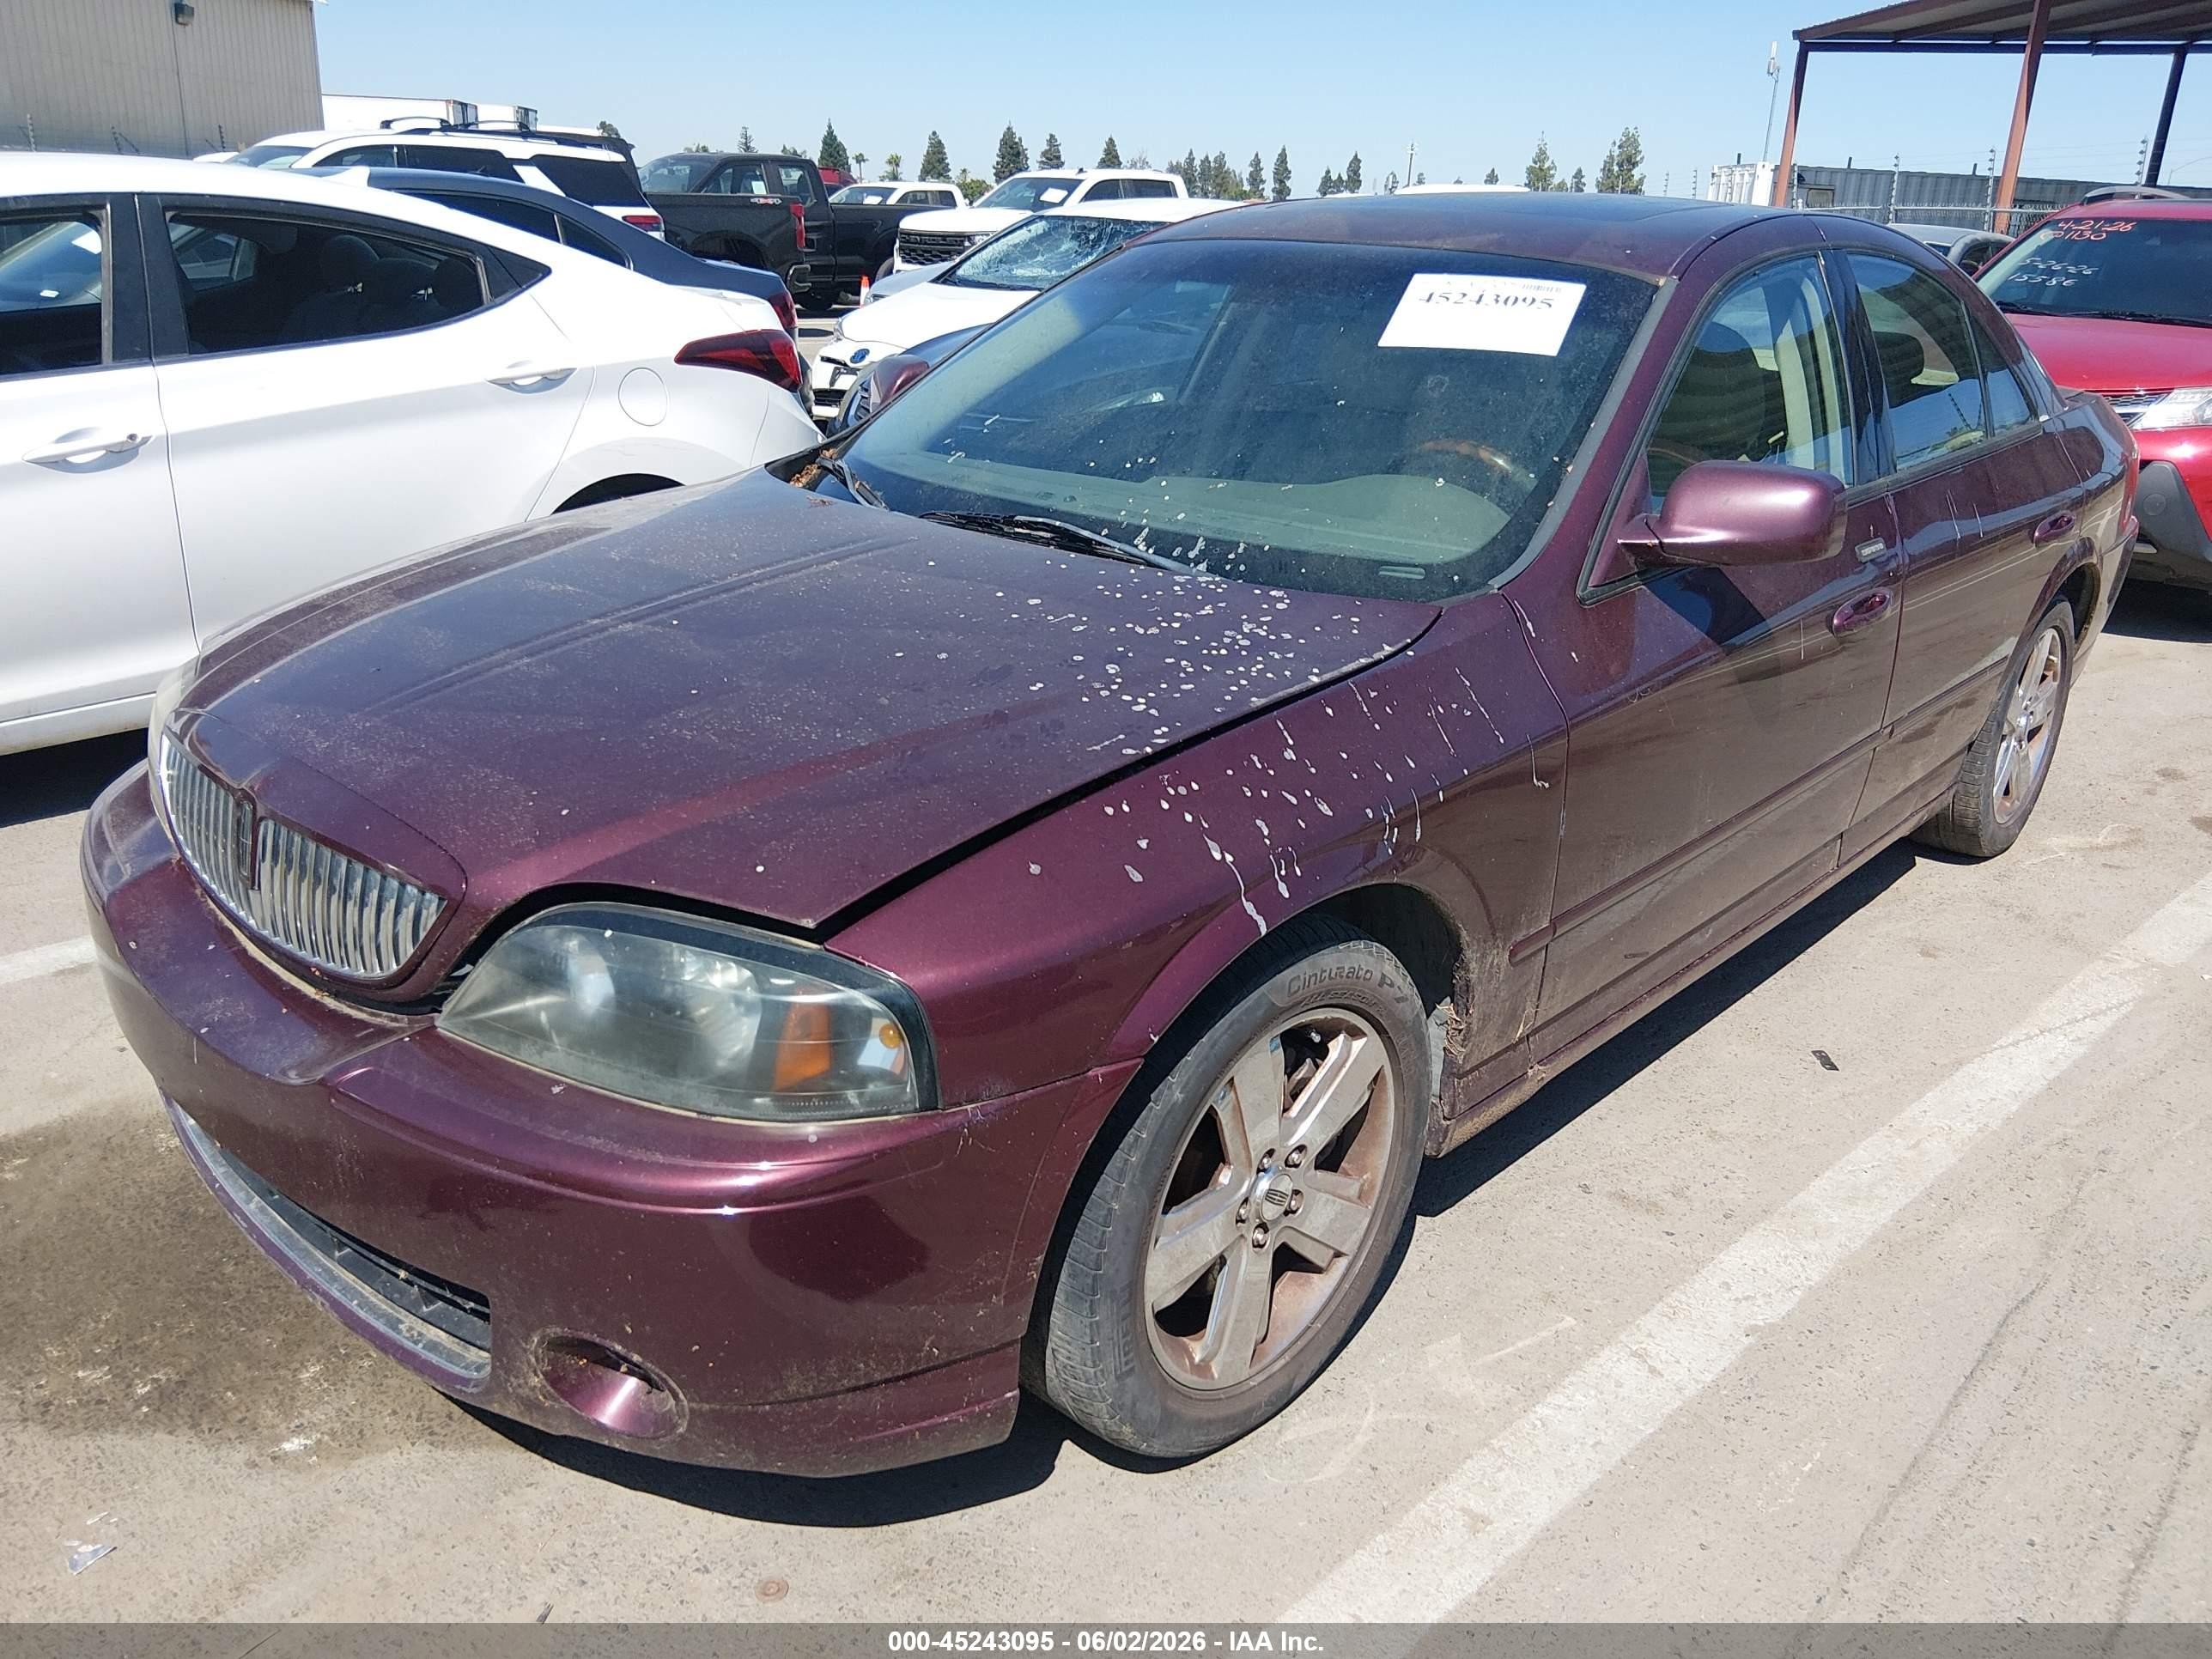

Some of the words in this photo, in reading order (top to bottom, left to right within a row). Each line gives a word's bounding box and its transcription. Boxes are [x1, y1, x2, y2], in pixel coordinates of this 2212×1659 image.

[2057, 220, 2137, 232] 4-21-26
[2018, 257, 2100, 276] 5-26-26
[1418, 291, 1555, 311] 45243095
[1287, 963, 1374, 997] Cinturato
